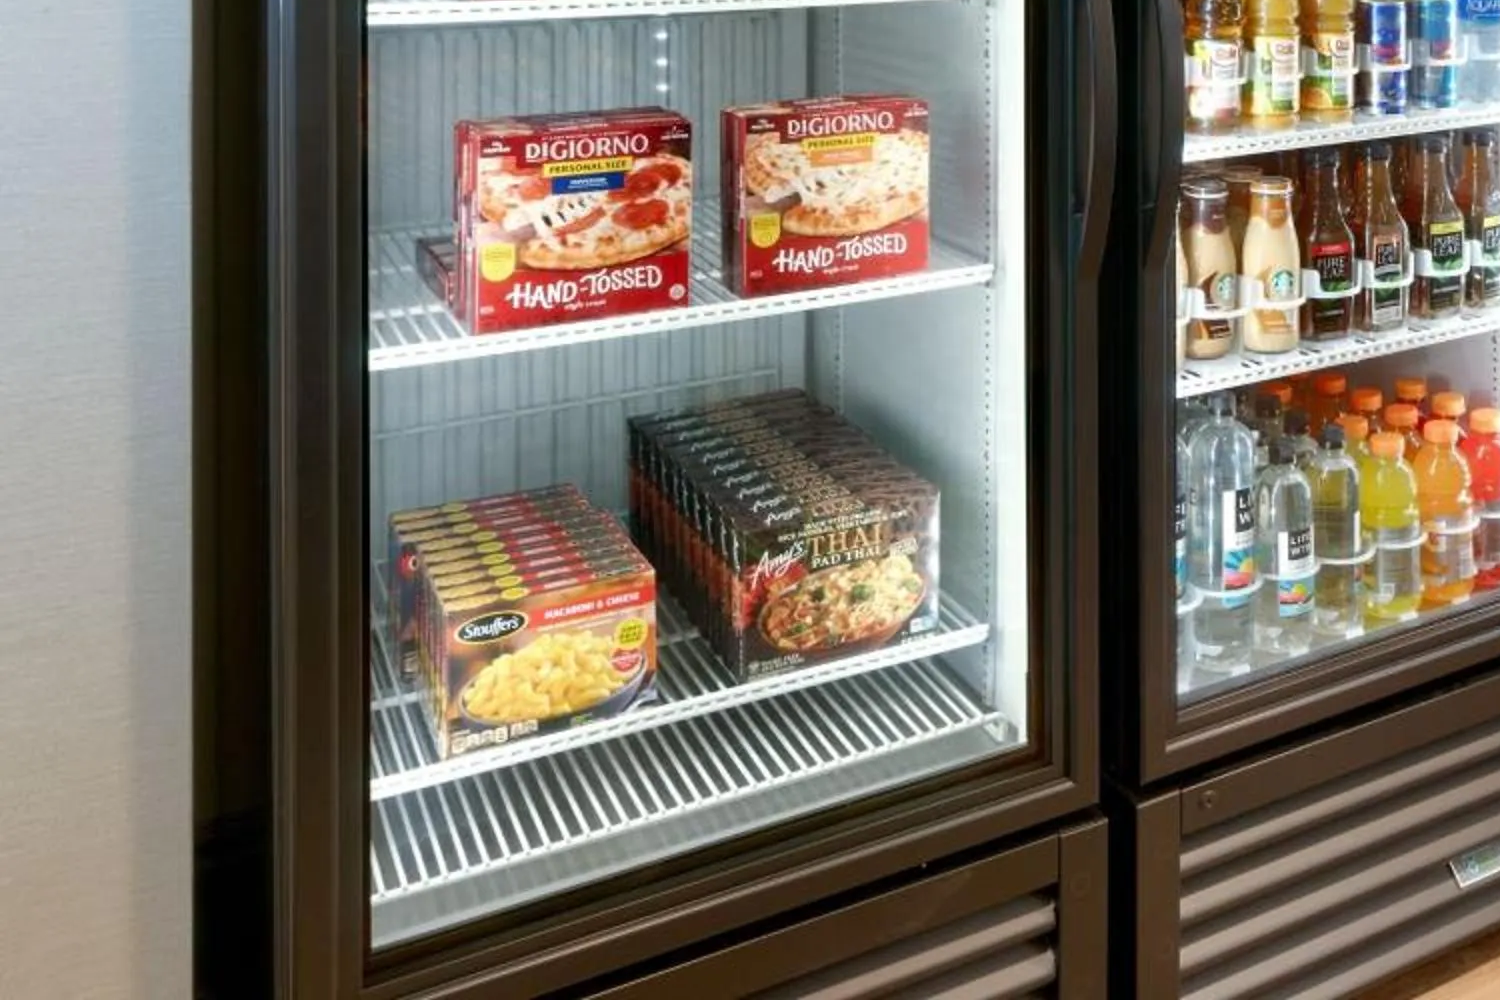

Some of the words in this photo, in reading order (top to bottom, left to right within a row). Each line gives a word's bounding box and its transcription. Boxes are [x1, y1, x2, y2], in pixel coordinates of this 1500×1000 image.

[505, 265, 663, 310] HAND-TOSSED
[811, 513, 884, 557] THAI
[812, 555, 841, 569] PAD
[845, 547, 882, 562] THAI
[462, 616, 520, 640] Stouffer's
